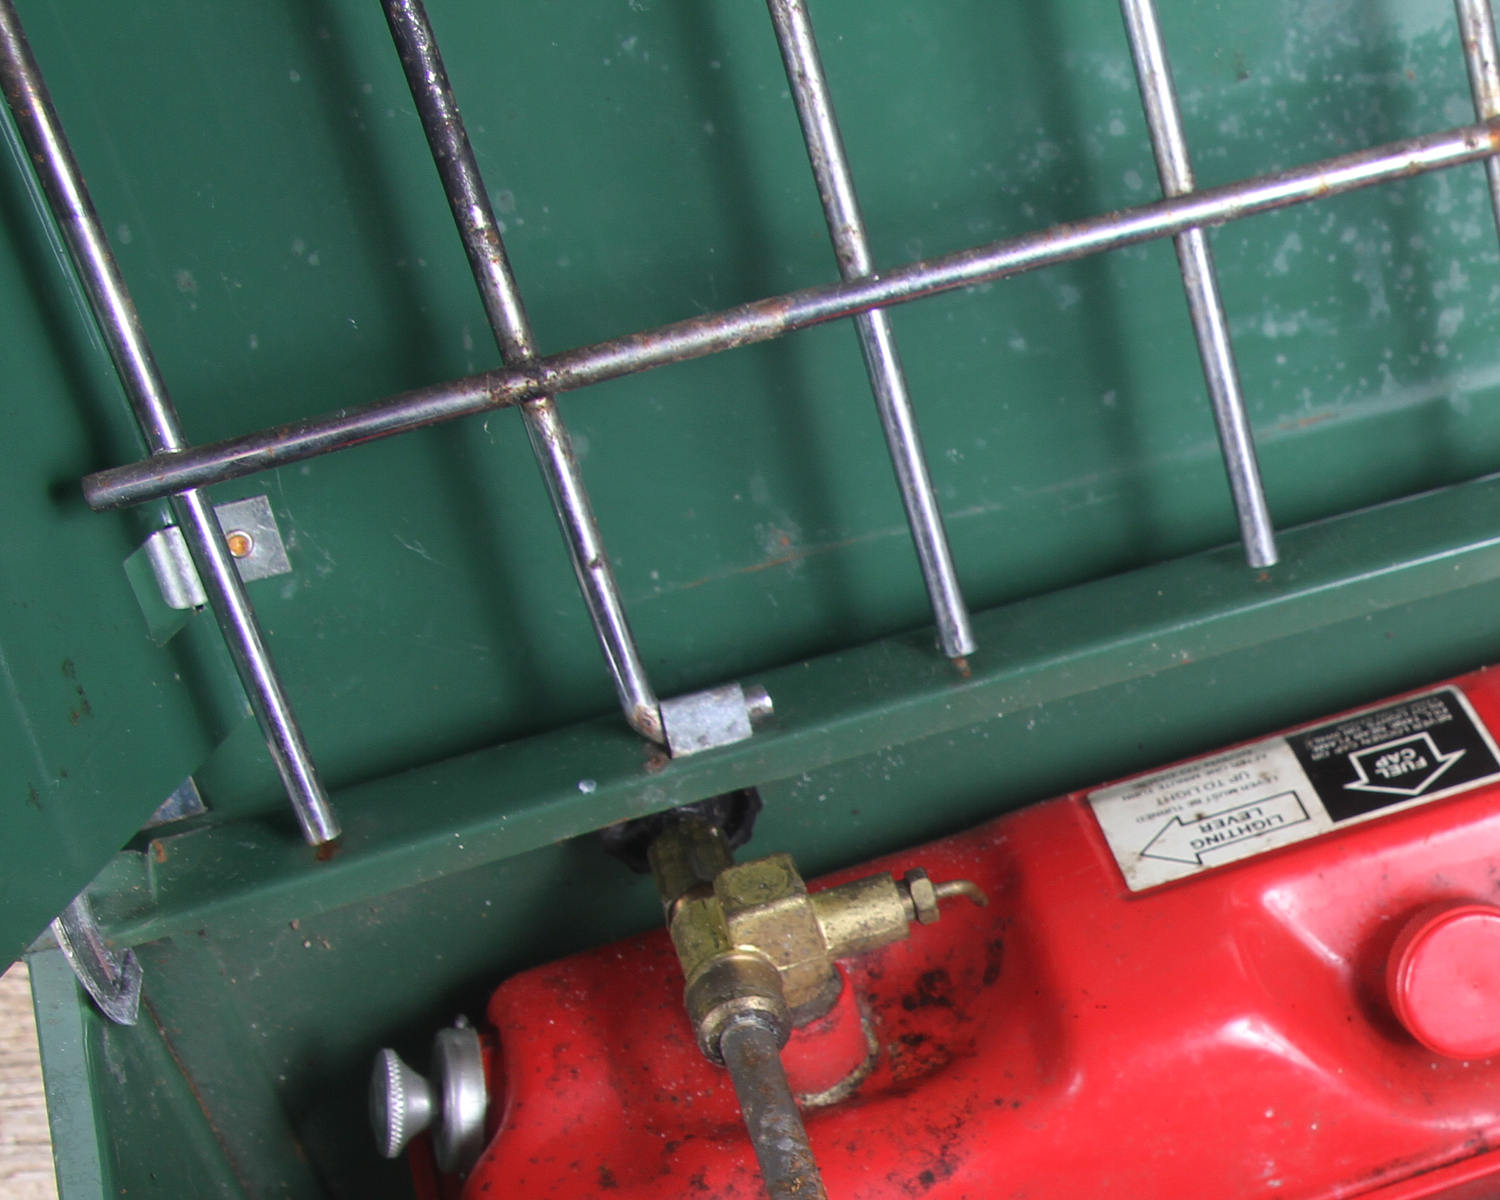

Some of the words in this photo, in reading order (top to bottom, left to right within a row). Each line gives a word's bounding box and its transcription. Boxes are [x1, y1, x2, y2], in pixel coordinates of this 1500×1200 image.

[1371, 746, 1417, 768] CAP
[1374, 755, 1428, 780] FUEL
[1202, 779, 1224, 791] TO
[1228, 771, 1249, 783] UP
[1154, 786, 1200, 805] LIGHT
[1198, 806, 1263, 833] LEVER
[1189, 814, 1283, 849] LIGHTING
